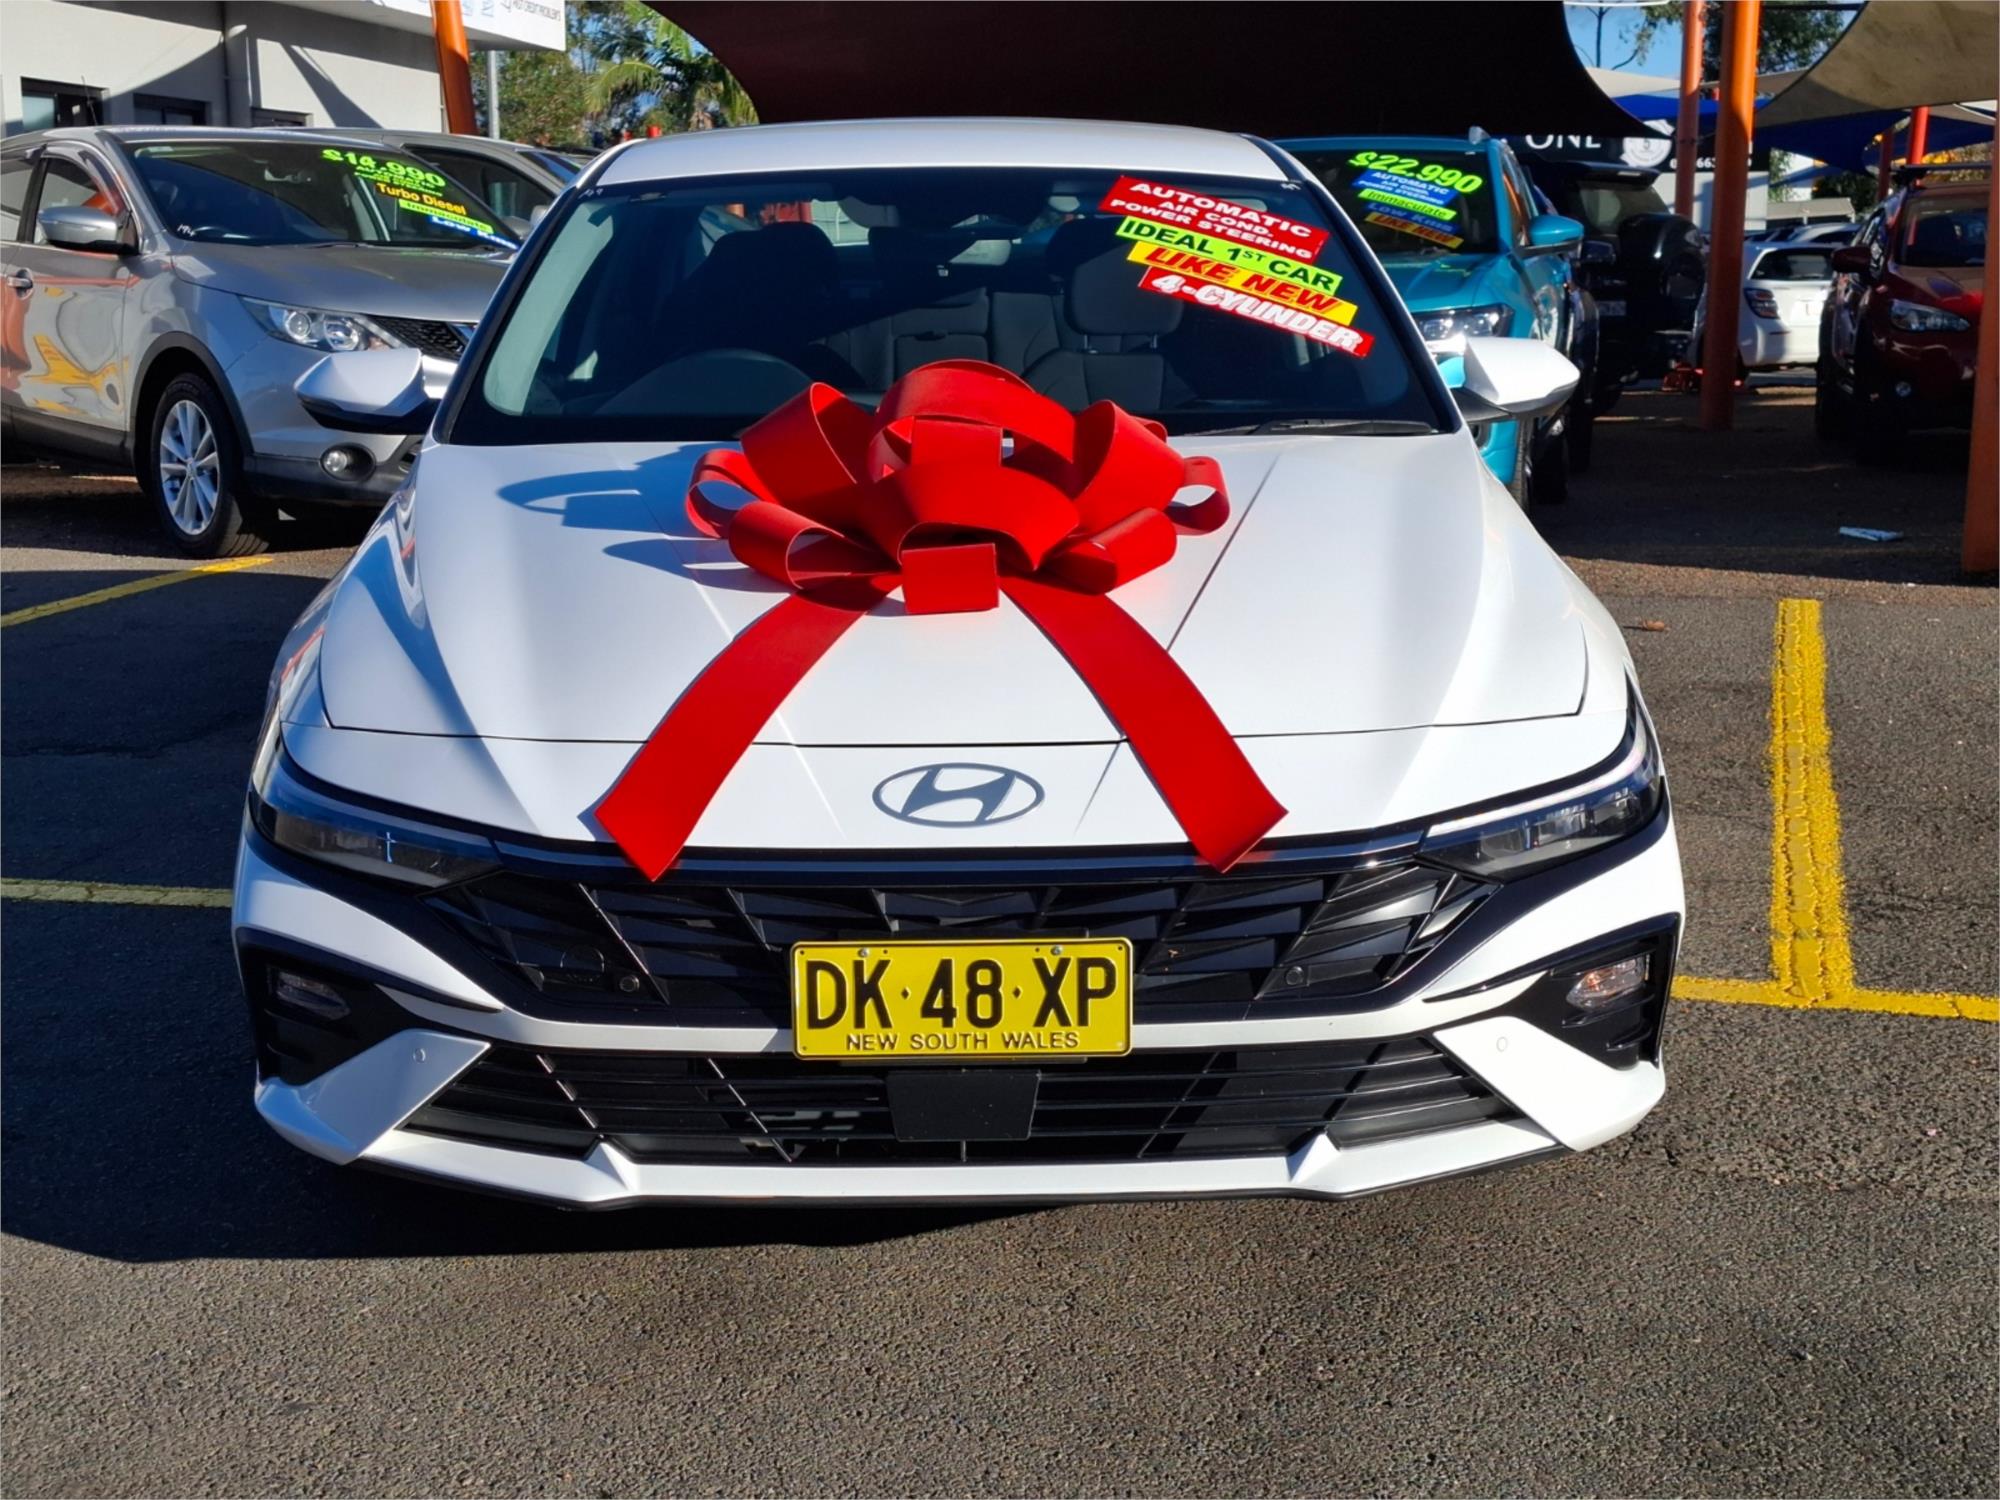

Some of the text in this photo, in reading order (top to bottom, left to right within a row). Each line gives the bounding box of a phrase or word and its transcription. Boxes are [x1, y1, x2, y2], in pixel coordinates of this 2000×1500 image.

[376, 183, 467, 215] Turbo Diesel
[1367, 190, 1448, 218] Immaculate
[1372, 172, 1449, 194] AUTOMATIC
[1110, 199, 1313, 260] POWER STEERING
[1130, 183, 1312, 238] AUTOMATIC
[1159, 200, 1274, 237] AIR COND.
[1123, 220, 1214, 255] IDEAL
[1268, 260, 1335, 292] CAR
[1145, 246, 1343, 312] LIKE NEW
[1152, 274, 1364, 351] 4-CYLINDER
[848, 1031, 1080, 1051] NEW SOUTH WALES
